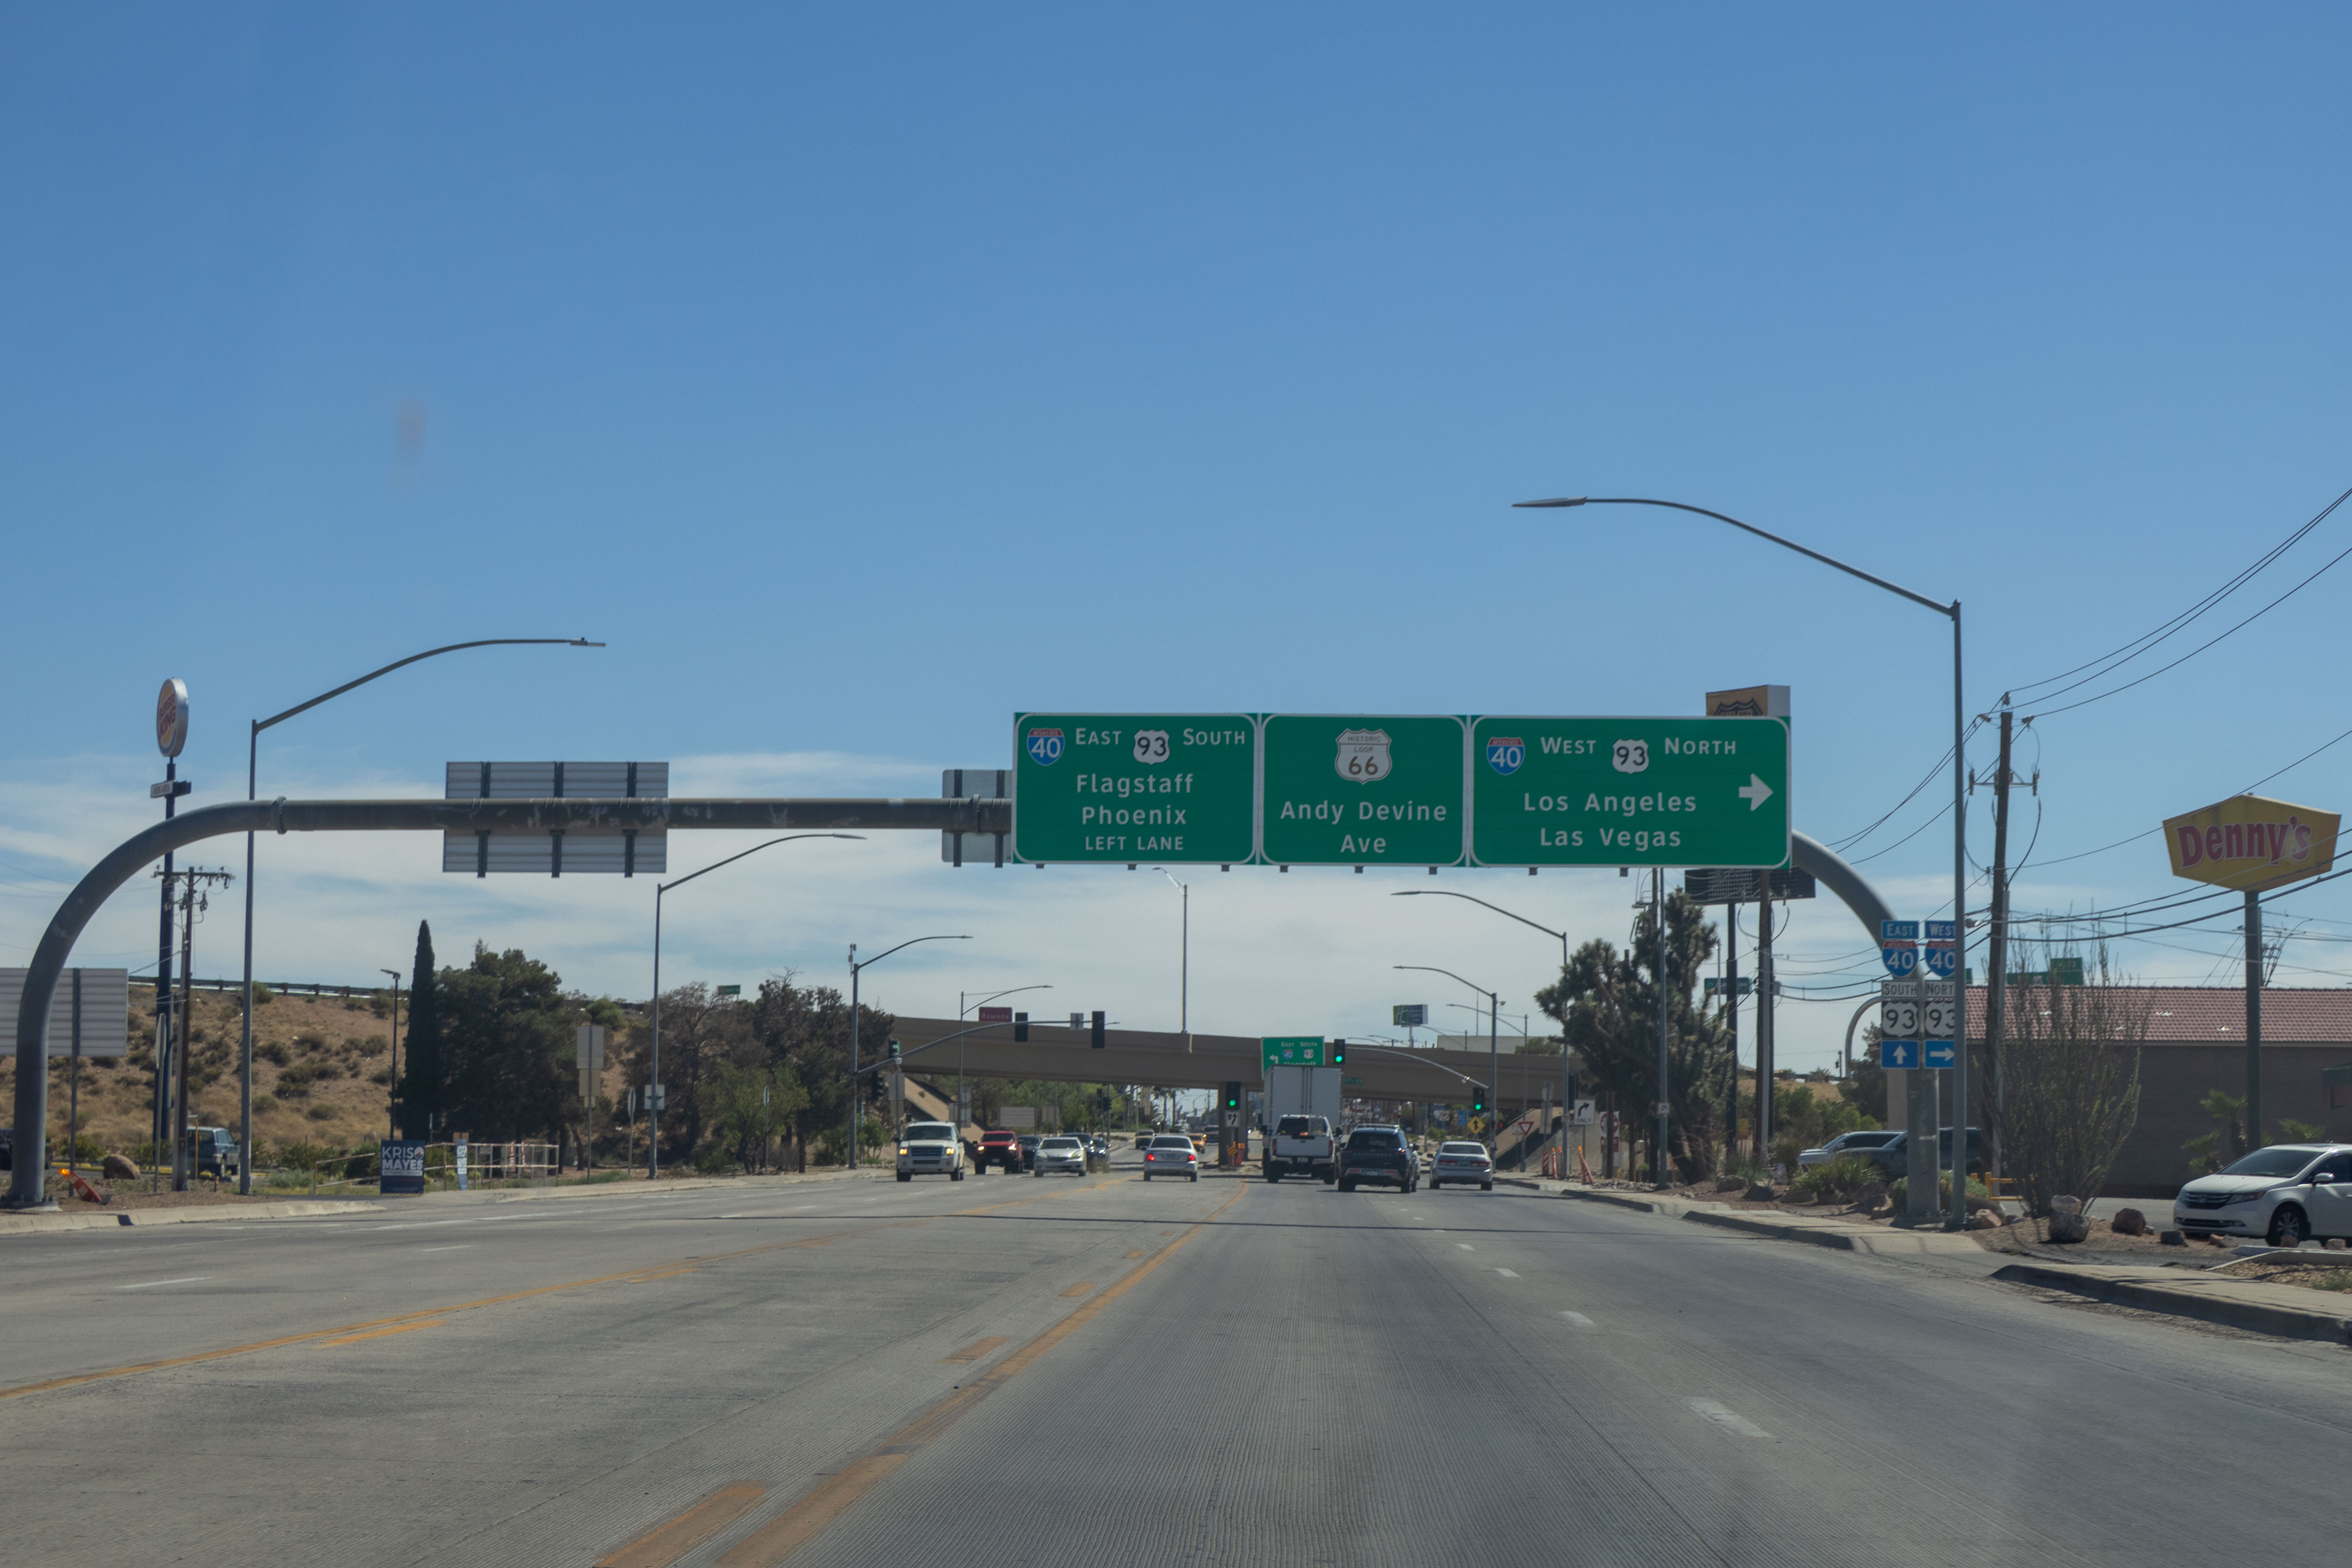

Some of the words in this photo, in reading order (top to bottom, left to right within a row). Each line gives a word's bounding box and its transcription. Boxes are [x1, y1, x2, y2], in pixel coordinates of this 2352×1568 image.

[1076, 728, 1122, 745] EAST
[1184, 728, 1245, 746] SOUTH
[1541, 737, 1597, 755] WEST
[1031, 737, 1061, 758] 40
[1137, 737, 1167, 757] 93
[1665, 738, 1736, 755] NORTH
[1349, 756, 1378, 776] 66
[1491, 746, 1522, 769] 40
[1616, 746, 1646, 767] 93
[1077, 774, 1193, 798] Flagstaff
[1281, 800, 1344, 825] Andy
[1359, 801, 1447, 822] Devine
[1525, 793, 1569, 812] Los
[1585, 792, 1697, 817] Angeles
[1083, 805, 1186, 826] Phoenix
[1086, 837, 1127, 851] LEFT
[1138, 837, 1184, 851] LANE
[1341, 835, 1386, 854] Ave
[1541, 828, 1584, 847] Las
[1600, 829, 1681, 852] Vegas
[2175, 815, 2311, 869] Denny's
[1887, 924, 1914, 937] EAST
[1887, 952, 1914, 970] 40
[1930, 952, 1955, 970] 40
[1884, 983, 1916, 995] SOUTH
[1928, 983, 1954, 995] NORT
[1886, 1009, 1915, 1028] 93
[1929, 1009, 1955, 1028] 93
[382, 1147, 414, 1159] KRIS
[382, 1159, 424, 1170] MAYES
